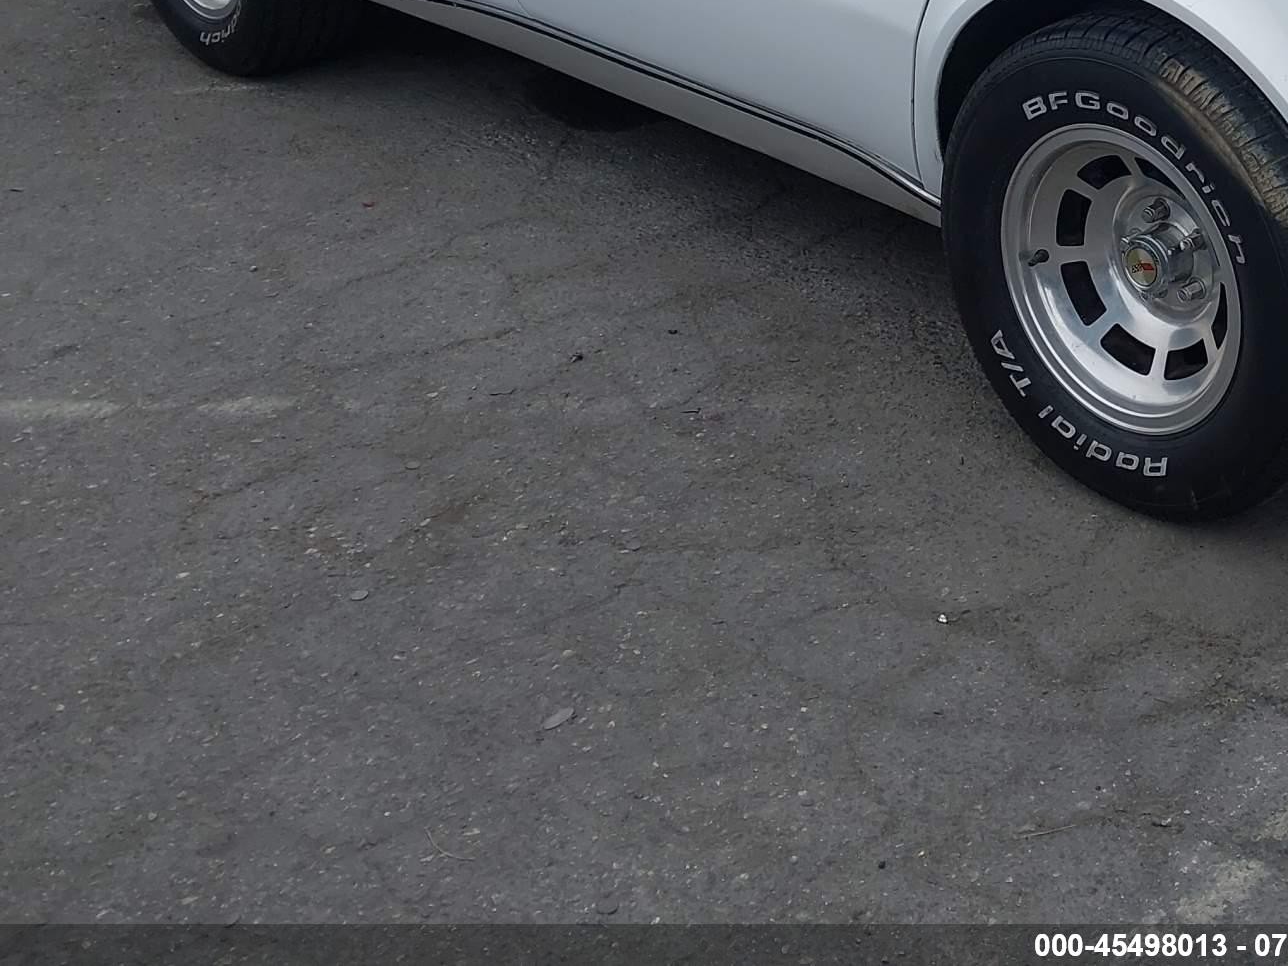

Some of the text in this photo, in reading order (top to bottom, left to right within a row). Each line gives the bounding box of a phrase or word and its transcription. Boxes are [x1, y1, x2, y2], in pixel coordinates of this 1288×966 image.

[1022, 90, 1248, 266] BFGoodrich
[990, 329, 1168, 478] Radial T/A
